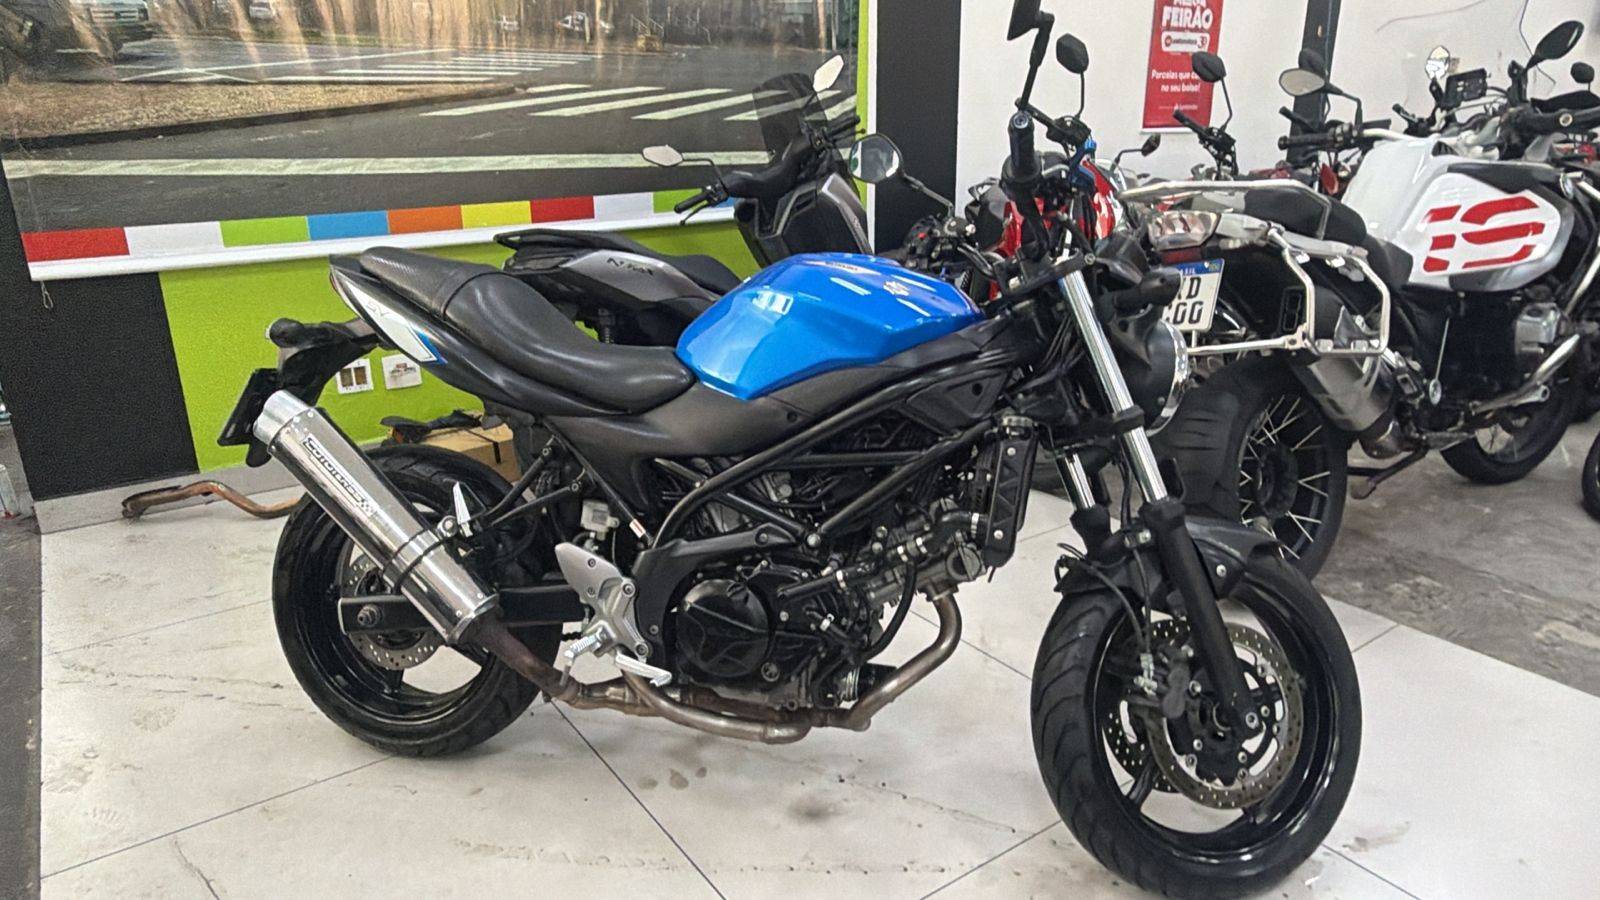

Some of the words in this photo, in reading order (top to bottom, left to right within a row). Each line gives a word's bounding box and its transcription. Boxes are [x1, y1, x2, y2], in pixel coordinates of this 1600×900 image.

[1151, 69, 1178, 80] Parcelas
[1178, 72, 1191, 81] que
[1160, 84, 1169, 92] no
[1170, 84, 1181, 92] seu
